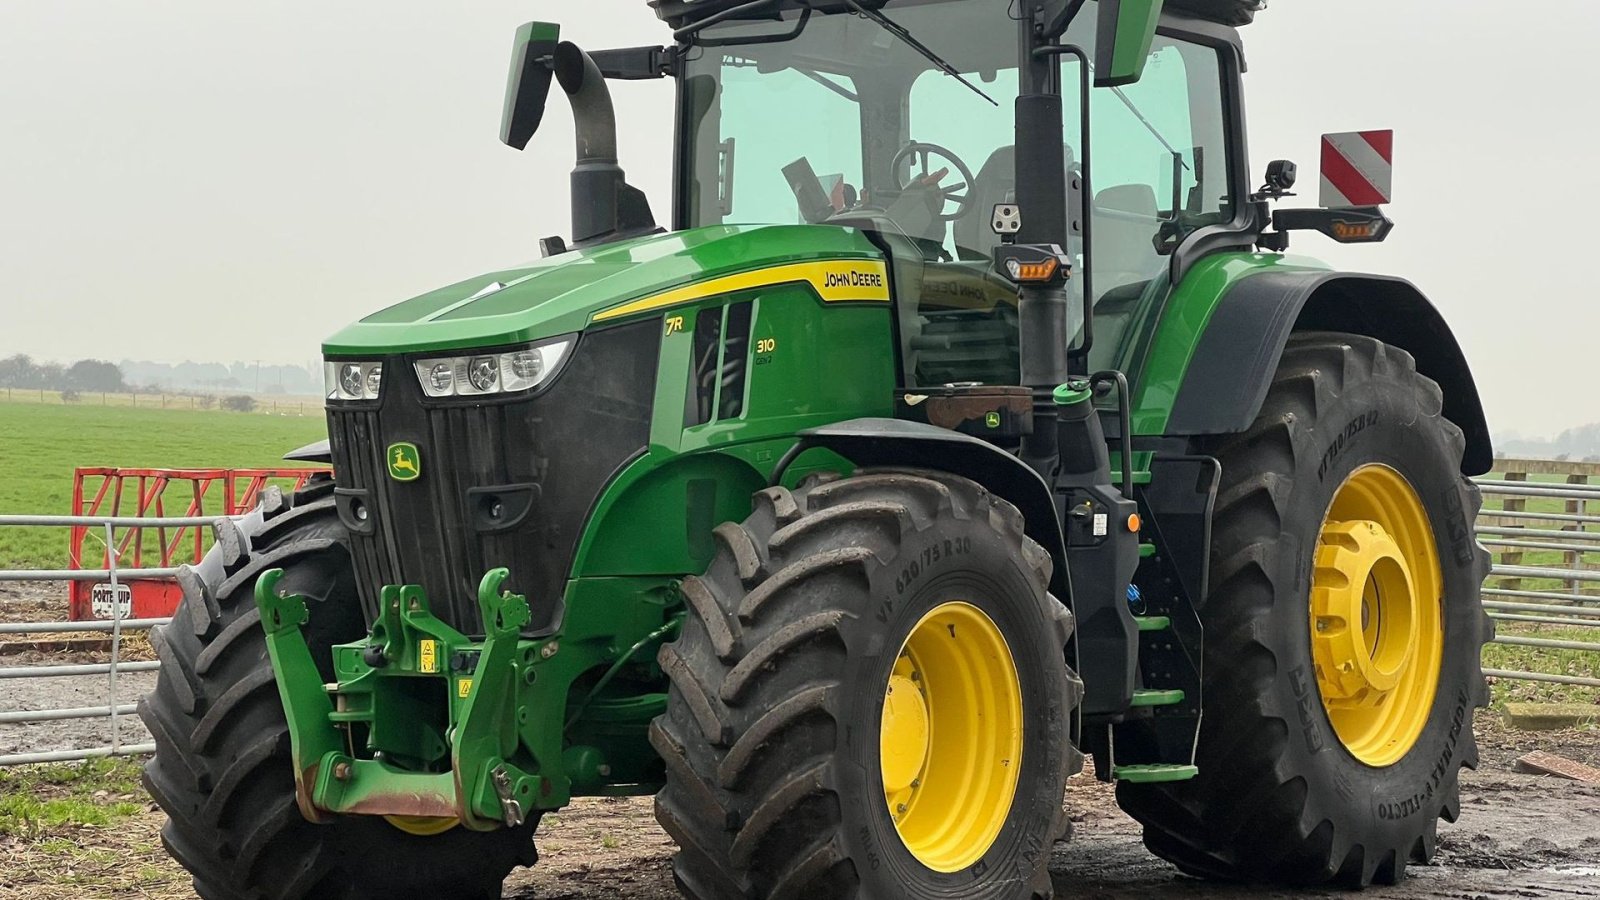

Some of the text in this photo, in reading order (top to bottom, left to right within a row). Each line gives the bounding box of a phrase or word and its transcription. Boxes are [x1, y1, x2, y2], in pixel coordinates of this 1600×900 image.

[825, 270, 882, 287] JOHN DEERE
[665, 316, 684, 337] 7R
[757, 338, 775, 354] 310
[93, 589, 130, 603] PORTEUIP
